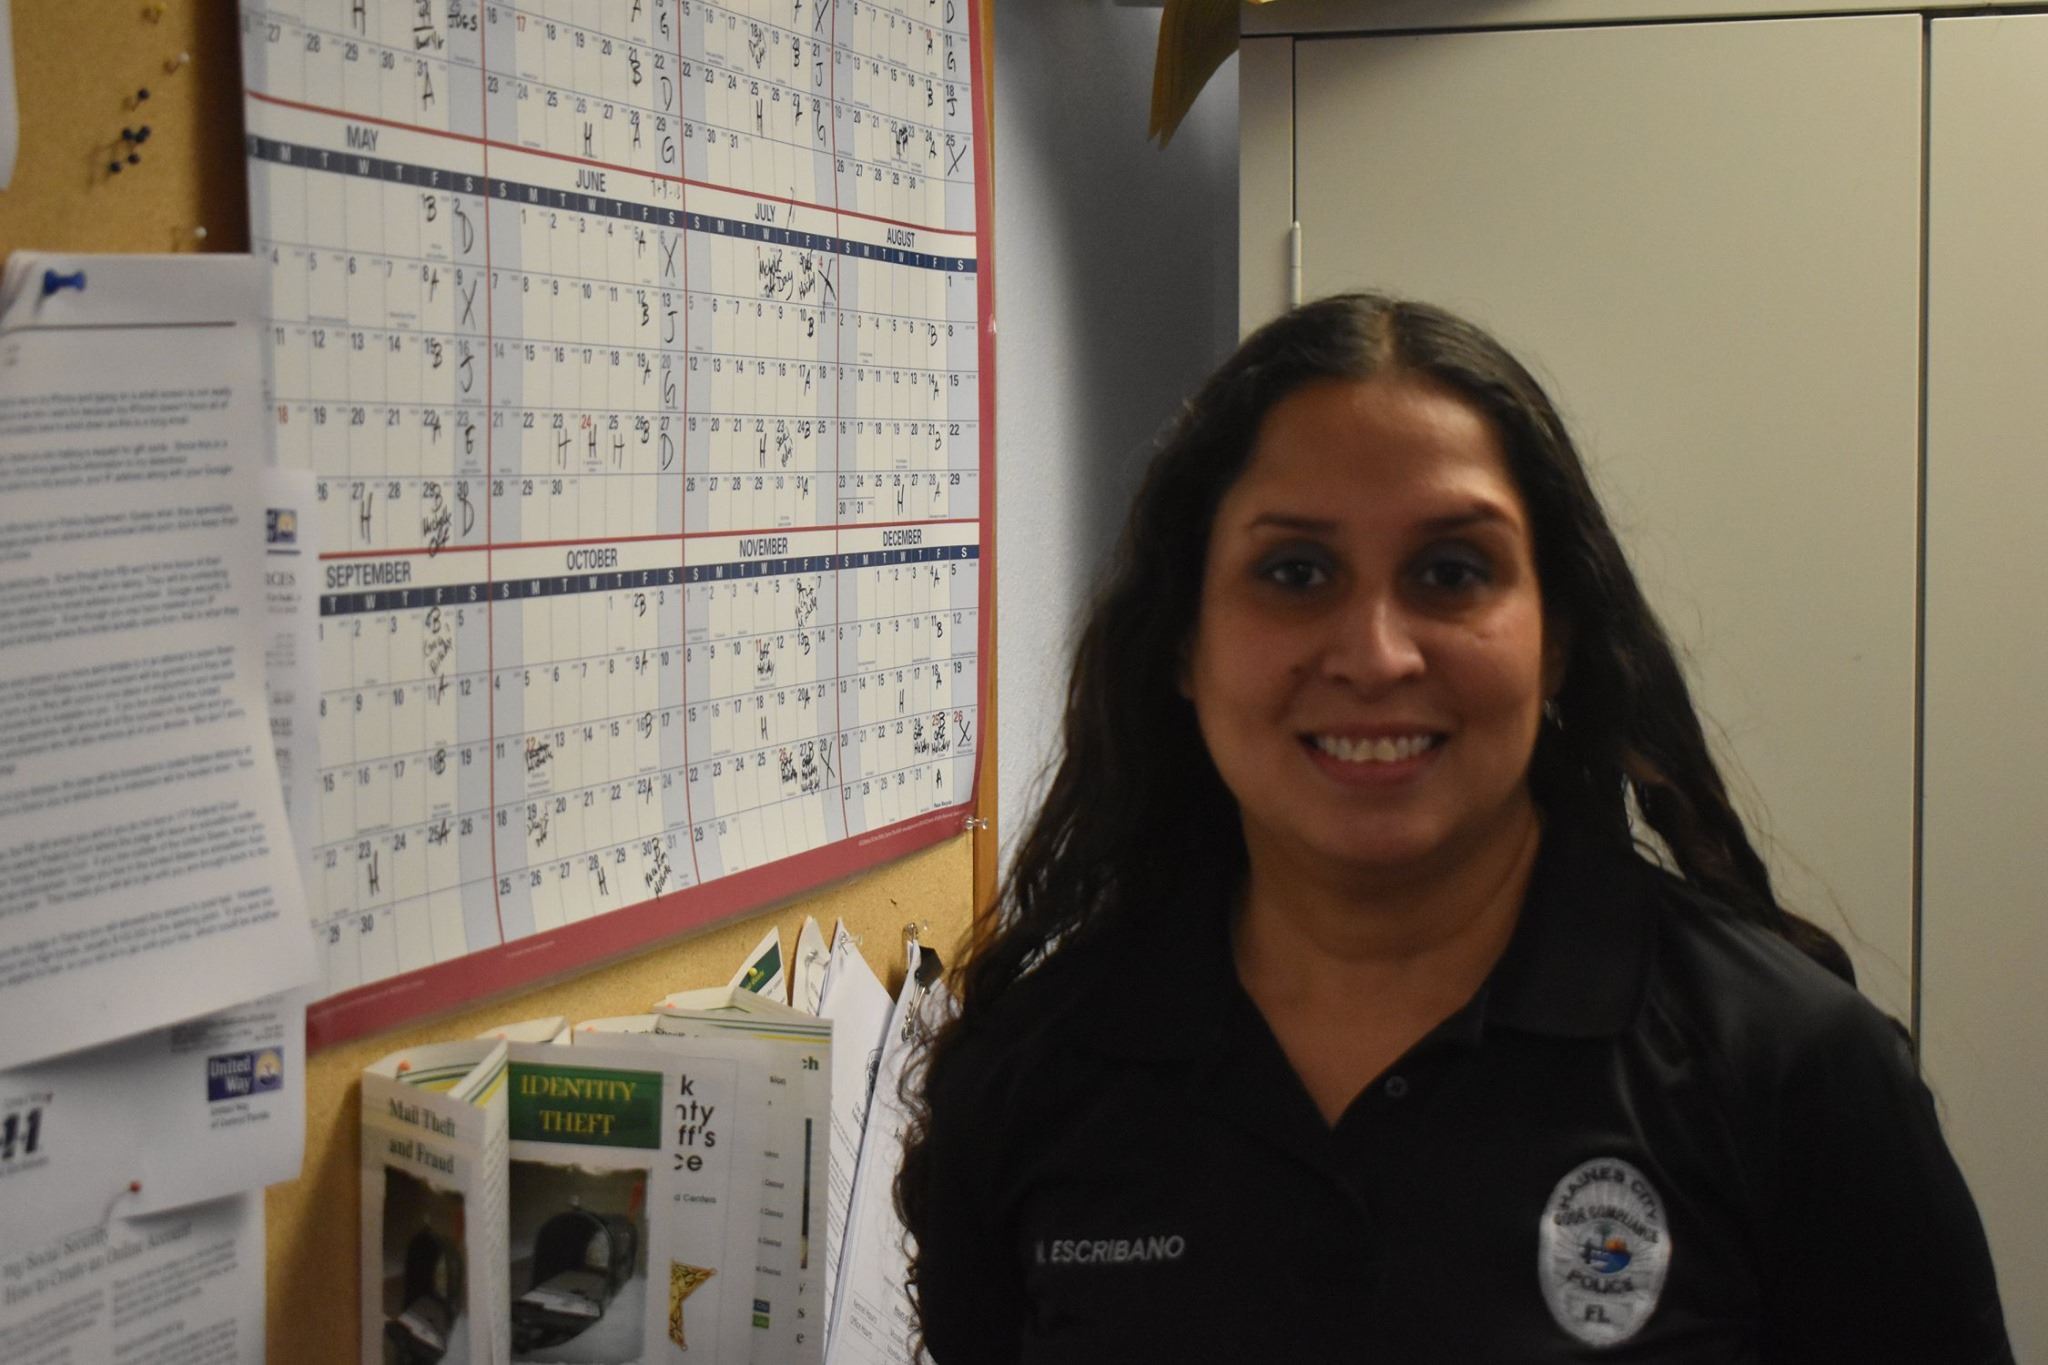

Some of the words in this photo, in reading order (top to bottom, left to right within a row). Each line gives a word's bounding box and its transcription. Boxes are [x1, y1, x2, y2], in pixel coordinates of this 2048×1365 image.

[267, 24, 280, 42] 27
[382, 51, 394, 70] 30
[517, 15, 526, 32] 17
[575, 32, 584, 48] 19
[601, 39, 612, 55] 20
[654, 53, 664, 70] 22
[945, 35, 952, 47] 11
[946, 84, 954, 97] 18
[547, 91, 558, 107] 25
[603, 104, 613, 120] 27
[347, 126, 378, 151] MAY
[946, 134, 955, 147] 25
[576, 170, 606, 192] JUNE
[837, 160, 844, 173] 26
[856, 164, 862, 177] 27
[875, 168, 881, 181] 28
[432, 172, 438, 183] F
[466, 177, 473, 191] S
[500, 183, 507, 197] S
[529, 188, 538, 202] M
[560, 194, 565, 206] T
[588, 198, 596, 212] W
[617, 203, 622, 215] T
[643, 208, 648, 220] F
[669, 212, 674, 224] S
[755, 203, 775, 222] JULY
[694, 217, 700, 229] S
[717, 220, 724, 233] M
[742, 224, 746, 236] T
[763, 228, 769, 240] W
[785, 232, 790, 243] T
[806, 236, 810, 246] F
[826, 239, 830, 250] S
[887, 228, 915, 248] AUGUST
[846, 243, 850, 253] S
[958, 260, 963, 270] S
[583, 283, 591, 298] 10
[663, 294, 671, 307] 13
[757, 304, 761, 317] 8
[800, 309, 806, 322] 10
[312, 330, 325, 348] 12
[352, 333, 364, 350] 13
[389, 336, 400, 352] 14
[948, 325, 953, 336] 8
[525, 345, 535, 360] 15
[555, 348, 564, 362] 16
[611, 351, 619, 366] 18
[690, 357, 697, 371] 12
[713, 358, 720, 372] 13
[736, 360, 743, 373] 14
[758, 362, 765, 375] 15
[819, 366, 826, 378] 18
[911, 373, 917, 384] 13
[950, 375, 958, 386] 15
[352, 408, 364, 425] 20
[523, 413, 533, 428] 22
[581, 415, 591, 429] 24
[661, 417, 669, 430] 27
[756, 419, 764, 432] 22
[950, 424, 959, 435] 22
[523, 480, 533, 495] 29
[552, 480, 562, 495] 30
[710, 477, 717, 491] 27
[732, 477, 741, 490] 28
[755, 477, 762, 490] 29
[951, 473, 960, 485] 29
[740, 537, 788, 557] NOVEMBER
[883, 529, 922, 546] DECEMBER
[567, 548, 618, 570] OCTOBER
[845, 556, 848, 566] S
[883, 553, 886, 563] T
[901, 552, 906, 561] W
[919, 550, 922, 560] T
[937, 549, 940, 558] F
[961, 548, 967, 557] S
[326, 561, 411, 588] SEPTEMBER
[694, 568, 698, 579] S
[716, 567, 722, 578] M
[741, 564, 745, 575] T
[761, 563, 767, 573] W
[783, 562, 787, 572] T
[804, 559, 808, 570] F
[825, 558, 829, 568] S
[952, 564, 956, 575] 5
[503, 584, 509, 597] S
[532, 581, 540, 594] M
[562, 579, 567, 591] T
[589, 577, 597, 589] W
[618, 574, 622, 586] T
[643, 572, 648, 584] F
[669, 570, 673, 583] S
[366, 595, 376, 609] W
[403, 592, 408, 605] T
[437, 589, 442, 602] F
[470, 586, 476, 600] S
[954, 613, 961, 624] 12
[954, 662, 962, 673] 19
[460, 679, 471, 696] 12
[954, 711, 962, 722] 26
[556, 732, 565, 747] 13
[584, 727, 592, 741] 14
[662, 713, 669, 726] 17
[690, 768, 698, 782] 22
[736, 758, 744, 771] 24
[210, 1053, 251, 1076] United
[226, 1074, 251, 1094] Way
[520, 1074, 636, 1101] IDENTITY
[681, 1075, 694, 1096] k
[390, 1098, 419, 1124] Mail
[423, 1105, 456, 1138] Theft
[539, 1110, 615, 1136] THEFT
[390, 1138, 412, 1159] and
[417, 1143, 454, 1174] Fraud
[1560, 1167, 1625, 1211] HAINES
[1632, 1180, 1657, 1219] CITY
[1051, 1236, 1185, 1262] ESCRIBANO
[1585, 1304, 1610, 1323] FL
